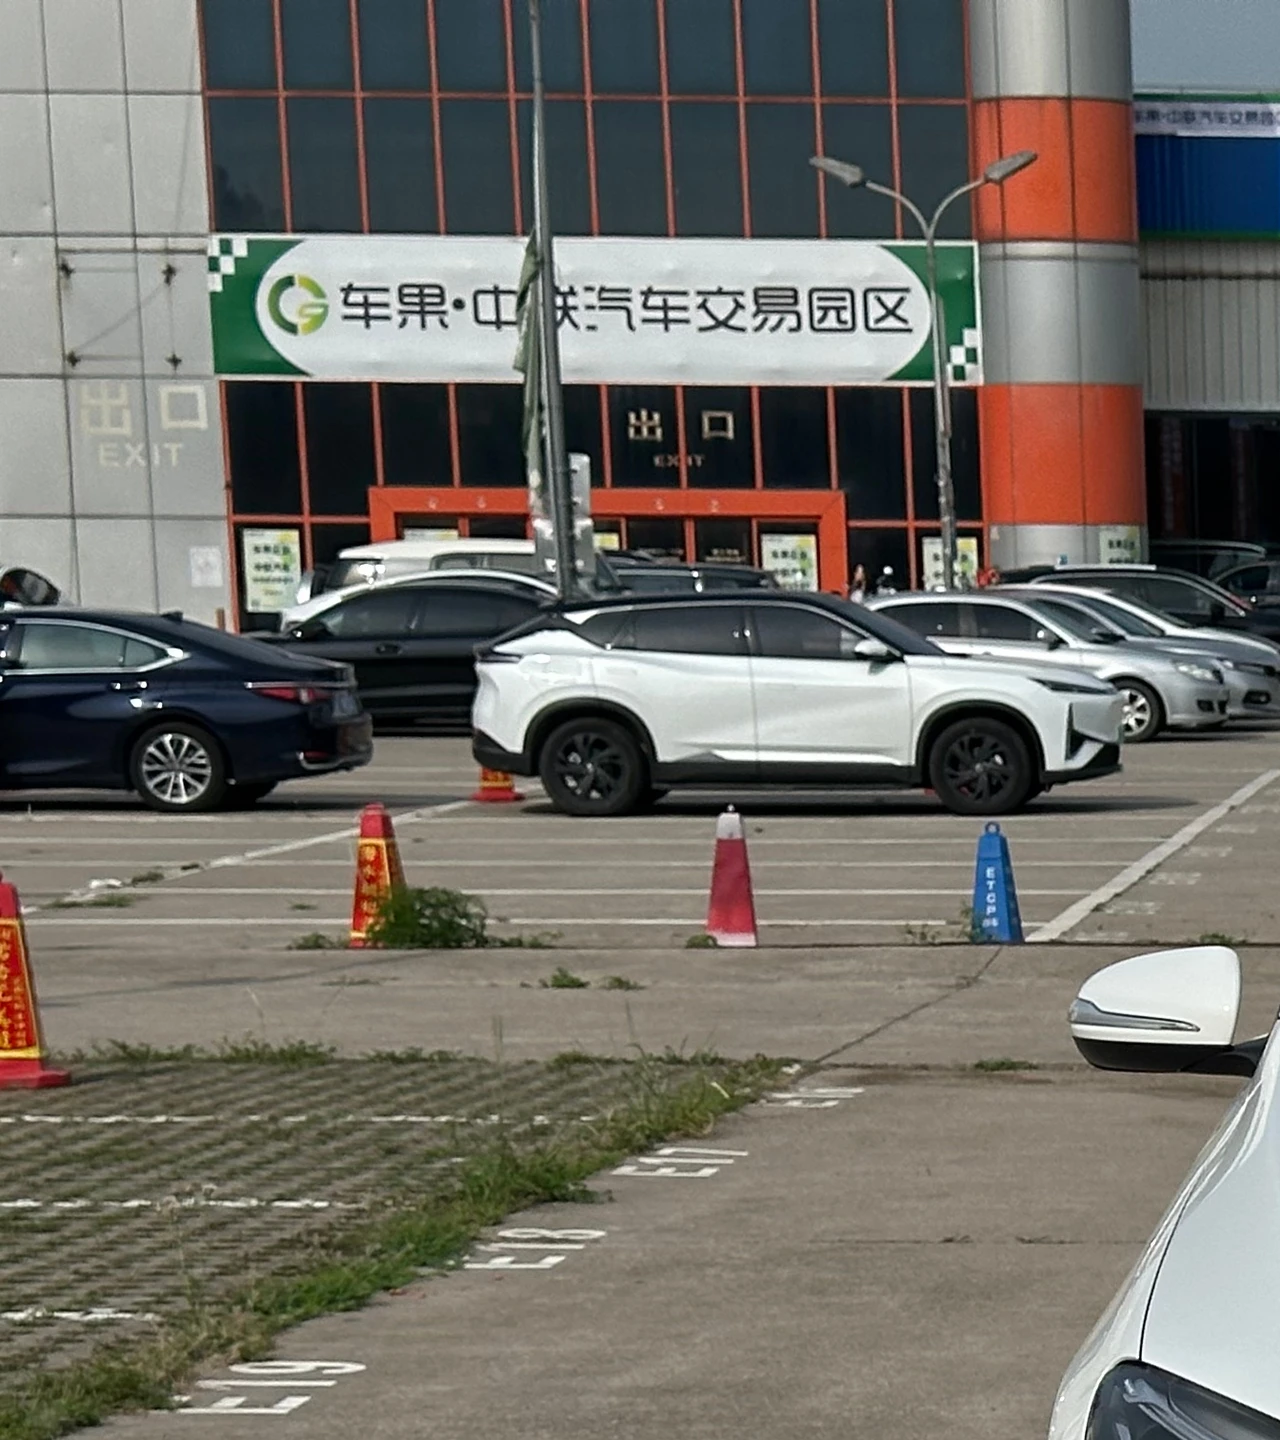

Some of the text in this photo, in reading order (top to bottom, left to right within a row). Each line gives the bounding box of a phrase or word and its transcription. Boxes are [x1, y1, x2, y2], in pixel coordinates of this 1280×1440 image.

[79, 384, 208, 436] 出口
[628, 408, 735, 442] 出口
[100, 443, 182, 467] EXIT
[460, 1227, 607, 1270] E18
[160, 1359, 367, 1415] E19
